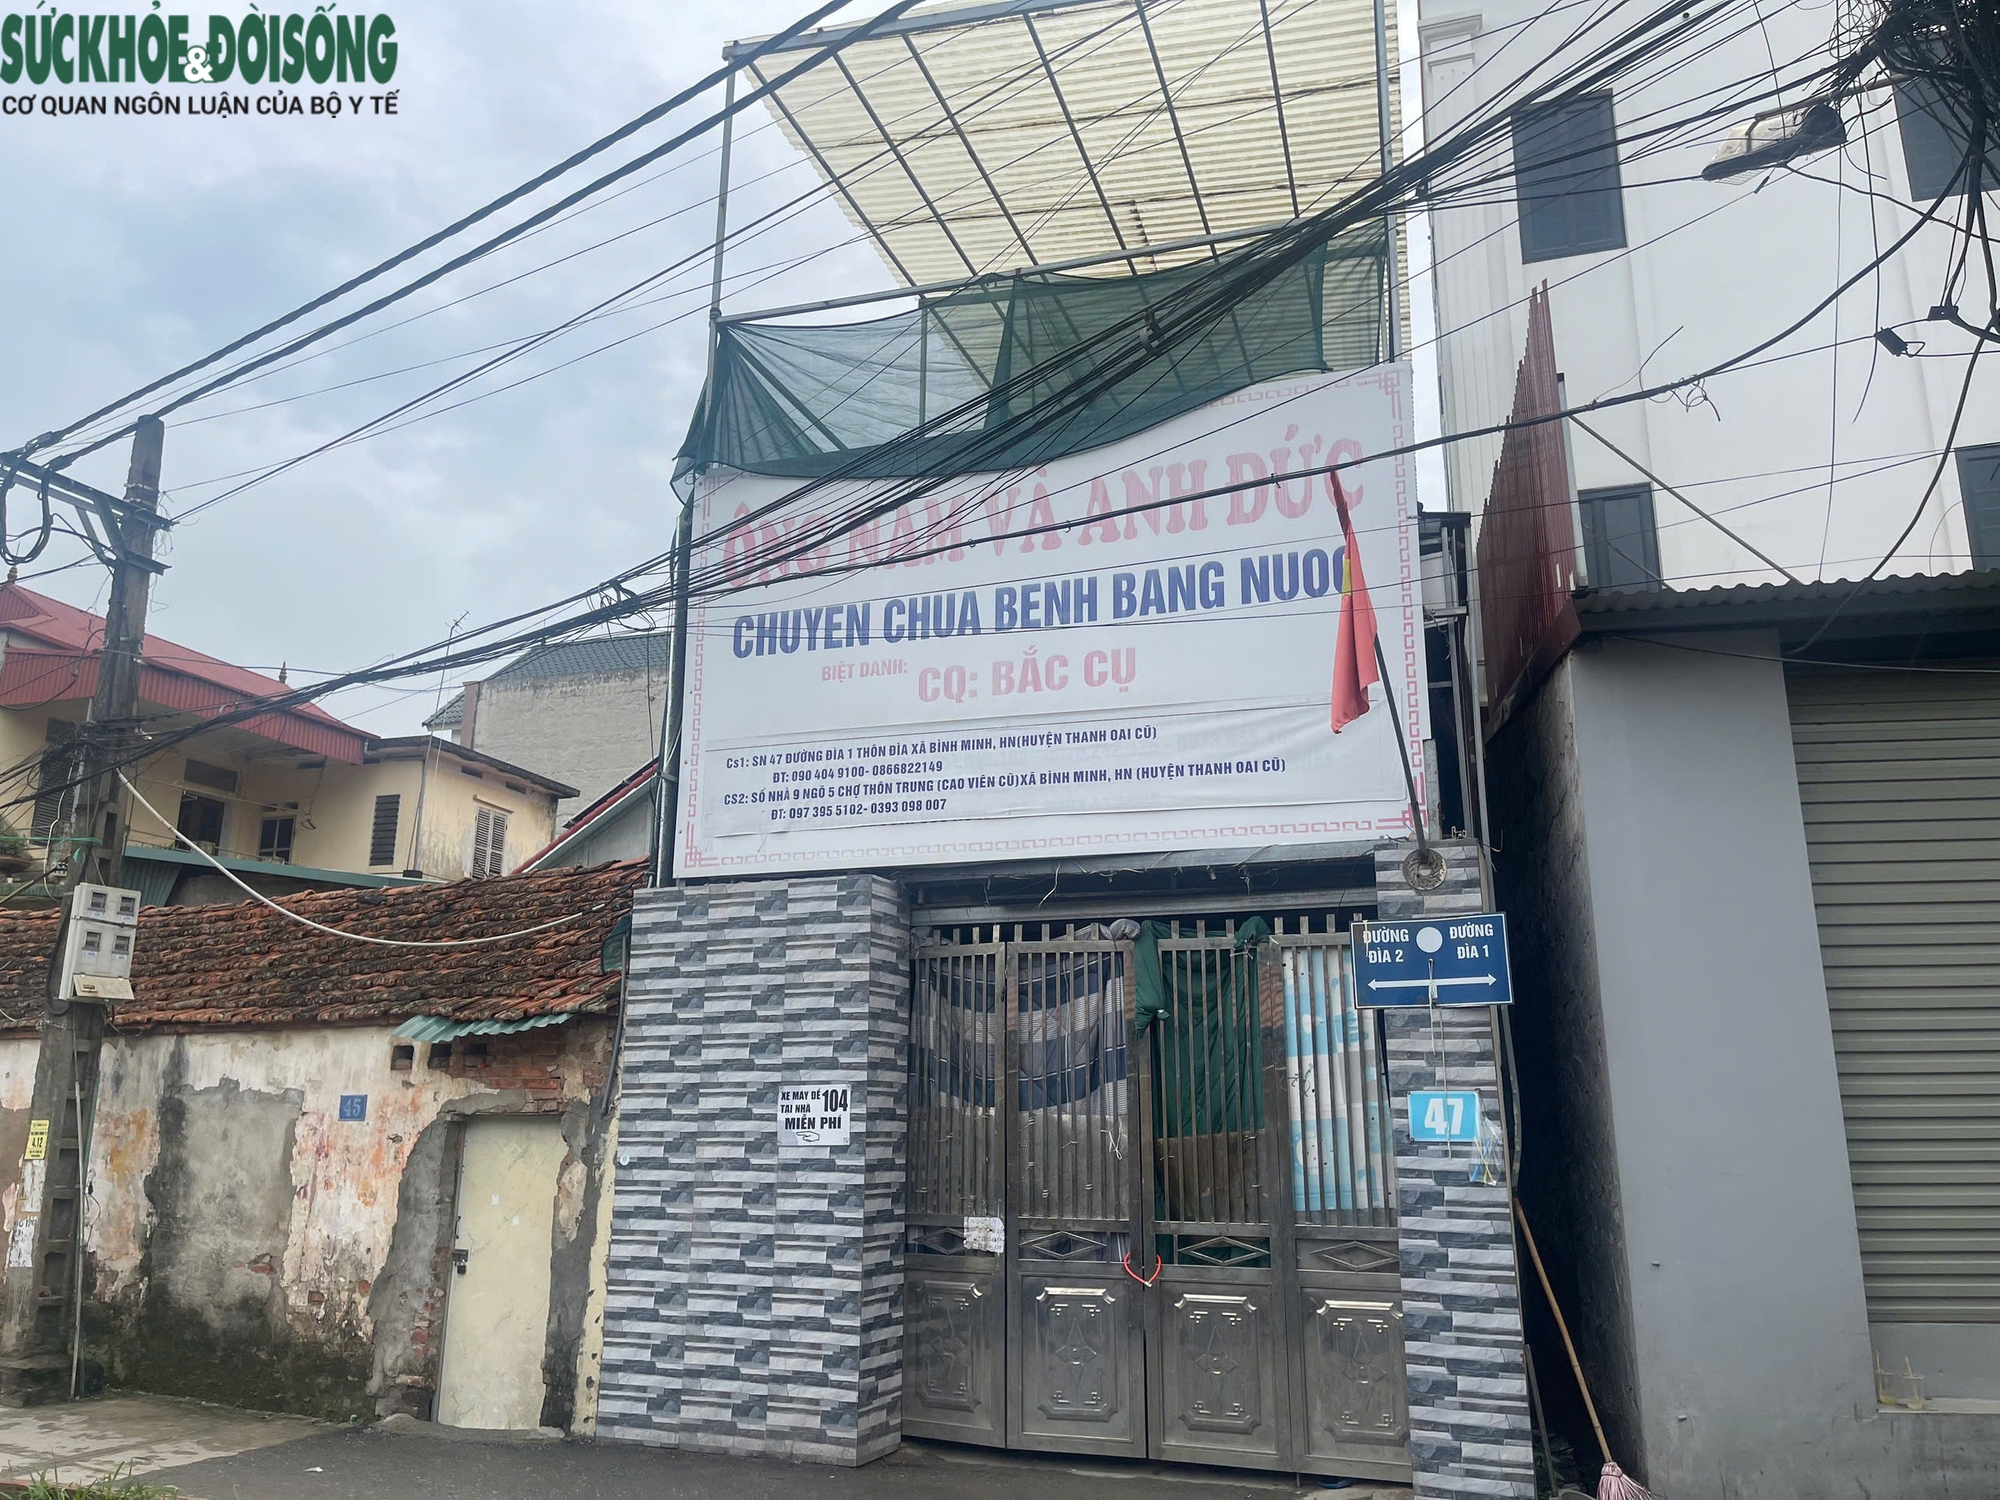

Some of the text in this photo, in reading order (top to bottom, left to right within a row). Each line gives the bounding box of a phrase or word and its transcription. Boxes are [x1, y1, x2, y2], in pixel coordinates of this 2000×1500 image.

[723, 501, 831, 587] ÔNG
[981, 467, 1062, 556] VÀ
[1078, 459, 1208, 545] ANH
[1225, 423, 1364, 525] ĐỨC
[732, 603, 871, 659] CHUYEN
[882, 591, 981, 643] CHUA
[994, 576, 1098, 632] BENH
[1112, 561, 1225, 619] BANG
[821, 645, 1136, 703] BIỆT DANH: CQ: BẮC CỤ
[752, 755, 767, 767] SN
[769, 754, 783, 765] 47
[785, 749, 823, 764] ĐƯỜNG
[825, 746, 845, 761] ĐÌA
[847, 748, 853, 759] 1
[857, 744, 886, 759] THÔN
[889, 742, 908, 756] ĐÌA
[911, 740, 927, 755] XÃ
[929, 739, 958, 753] BÌNH
[960, 738, 996, 751] MINH,
[1065, 730, 1107, 744] THANH
[1110, 728, 1131, 741] OAI
[1135, 725, 1157, 739] CŨ)
[724, 793, 749, 805] CS2:
[751, 787, 766, 803] SỐ
[768, 787, 790, 802] NHÀ
[793, 789, 800, 800] 9
[802, 785, 826, 799] NGÕ
[828, 786, 835, 797] 5
[837, 784, 861, 799] CHỢ
[863, 781, 893, 796] THÔN
[896, 779, 934, 793] TRUNG
[937, 778, 965, 792] (CAO
[967, 775, 995, 789] VIÊN
[1040, 770, 1070, 785] BÌNH
[1073, 769, 1111, 783] MINH,
[1114, 768, 1133, 781] HN
[1136, 763, 1185, 780] (HUYỆN
[1188, 762, 1232, 776] THANH
[1236, 760, 1258, 773] OAI
[1262, 757, 1286, 772] CŨ)
[772, 772, 789, 783] ĐT:
[791, 770, 812, 781] 090
[814, 768, 835, 780] 404
[872, 760, 943, 776] 0866822149
[771, 809, 787, 820] ĐT:
[789, 807, 810, 818] 097
[812, 805, 833, 817] 395
[870, 802, 899, 814] 0393
[901, 800, 923, 812] 098
[925, 799, 947, 811] 007
[1363, 926, 1410, 944] ĐƯỜNG
[1449, 922, 1494, 939] ĐƯỜNG
[1368, 947, 1404, 963] ĐÌA 2
[1457, 943, 1489, 959] ĐÌA 1
[781, 1091, 791, 1100] XE
[822, 1089, 848, 1112] 104
[343, 1099, 361, 1116] 45
[1424, 1098, 1464, 1135] 47
[785, 1113, 842, 1130] MIỄN PHÍ
